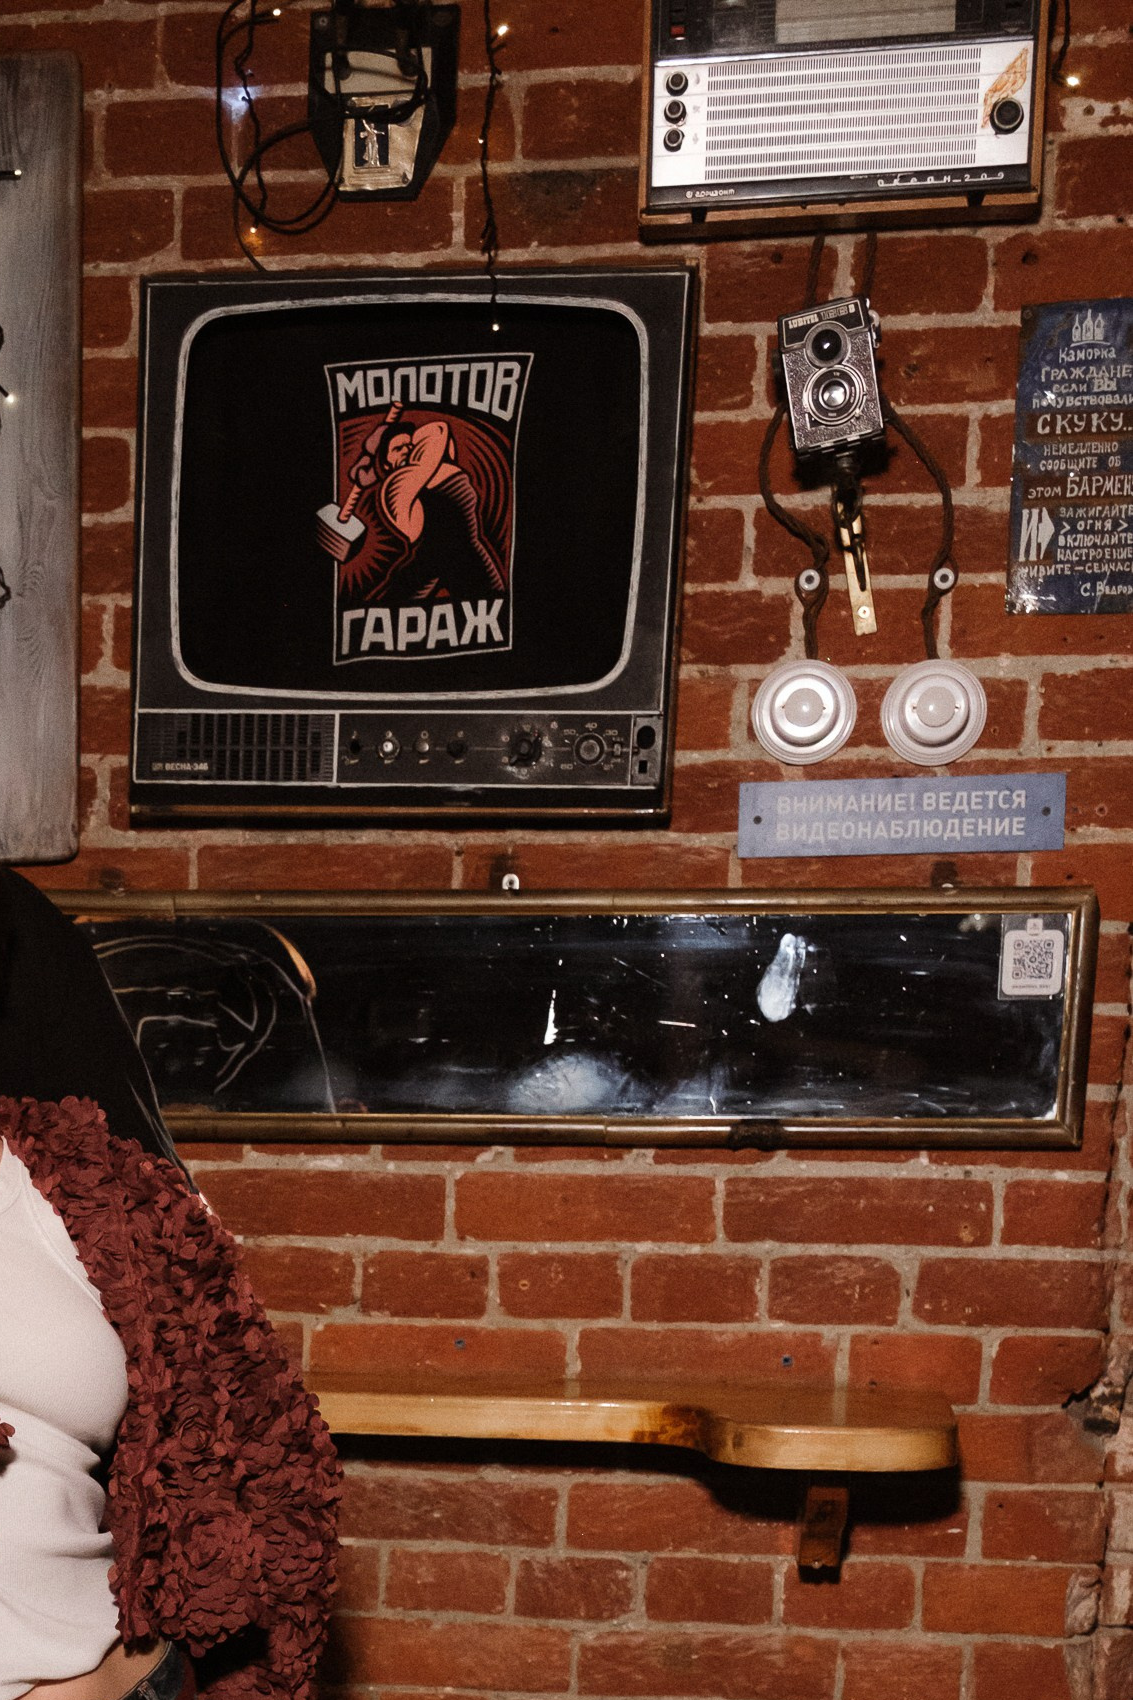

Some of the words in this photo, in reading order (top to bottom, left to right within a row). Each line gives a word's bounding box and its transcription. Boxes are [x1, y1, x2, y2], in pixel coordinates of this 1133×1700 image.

[1058, 346, 1117, 364] Каморка
[335, 361, 522, 422] МОЛОТОВ
[1039, 456, 1098, 473] СООБЩИТЕ
[1108, 455, 1122, 468] ОБ
[1066, 473, 1133, 498] БАРМЕН
[341, 598, 505, 656] ГАРАЖ
[776, 793, 916, 815] ВНИМАНИЕ!
[922, 789, 1027, 814] ВЕДЕТСЯ
[776, 816, 1026, 843] ВИДЕОНАБЛЮДЕНИЕ
